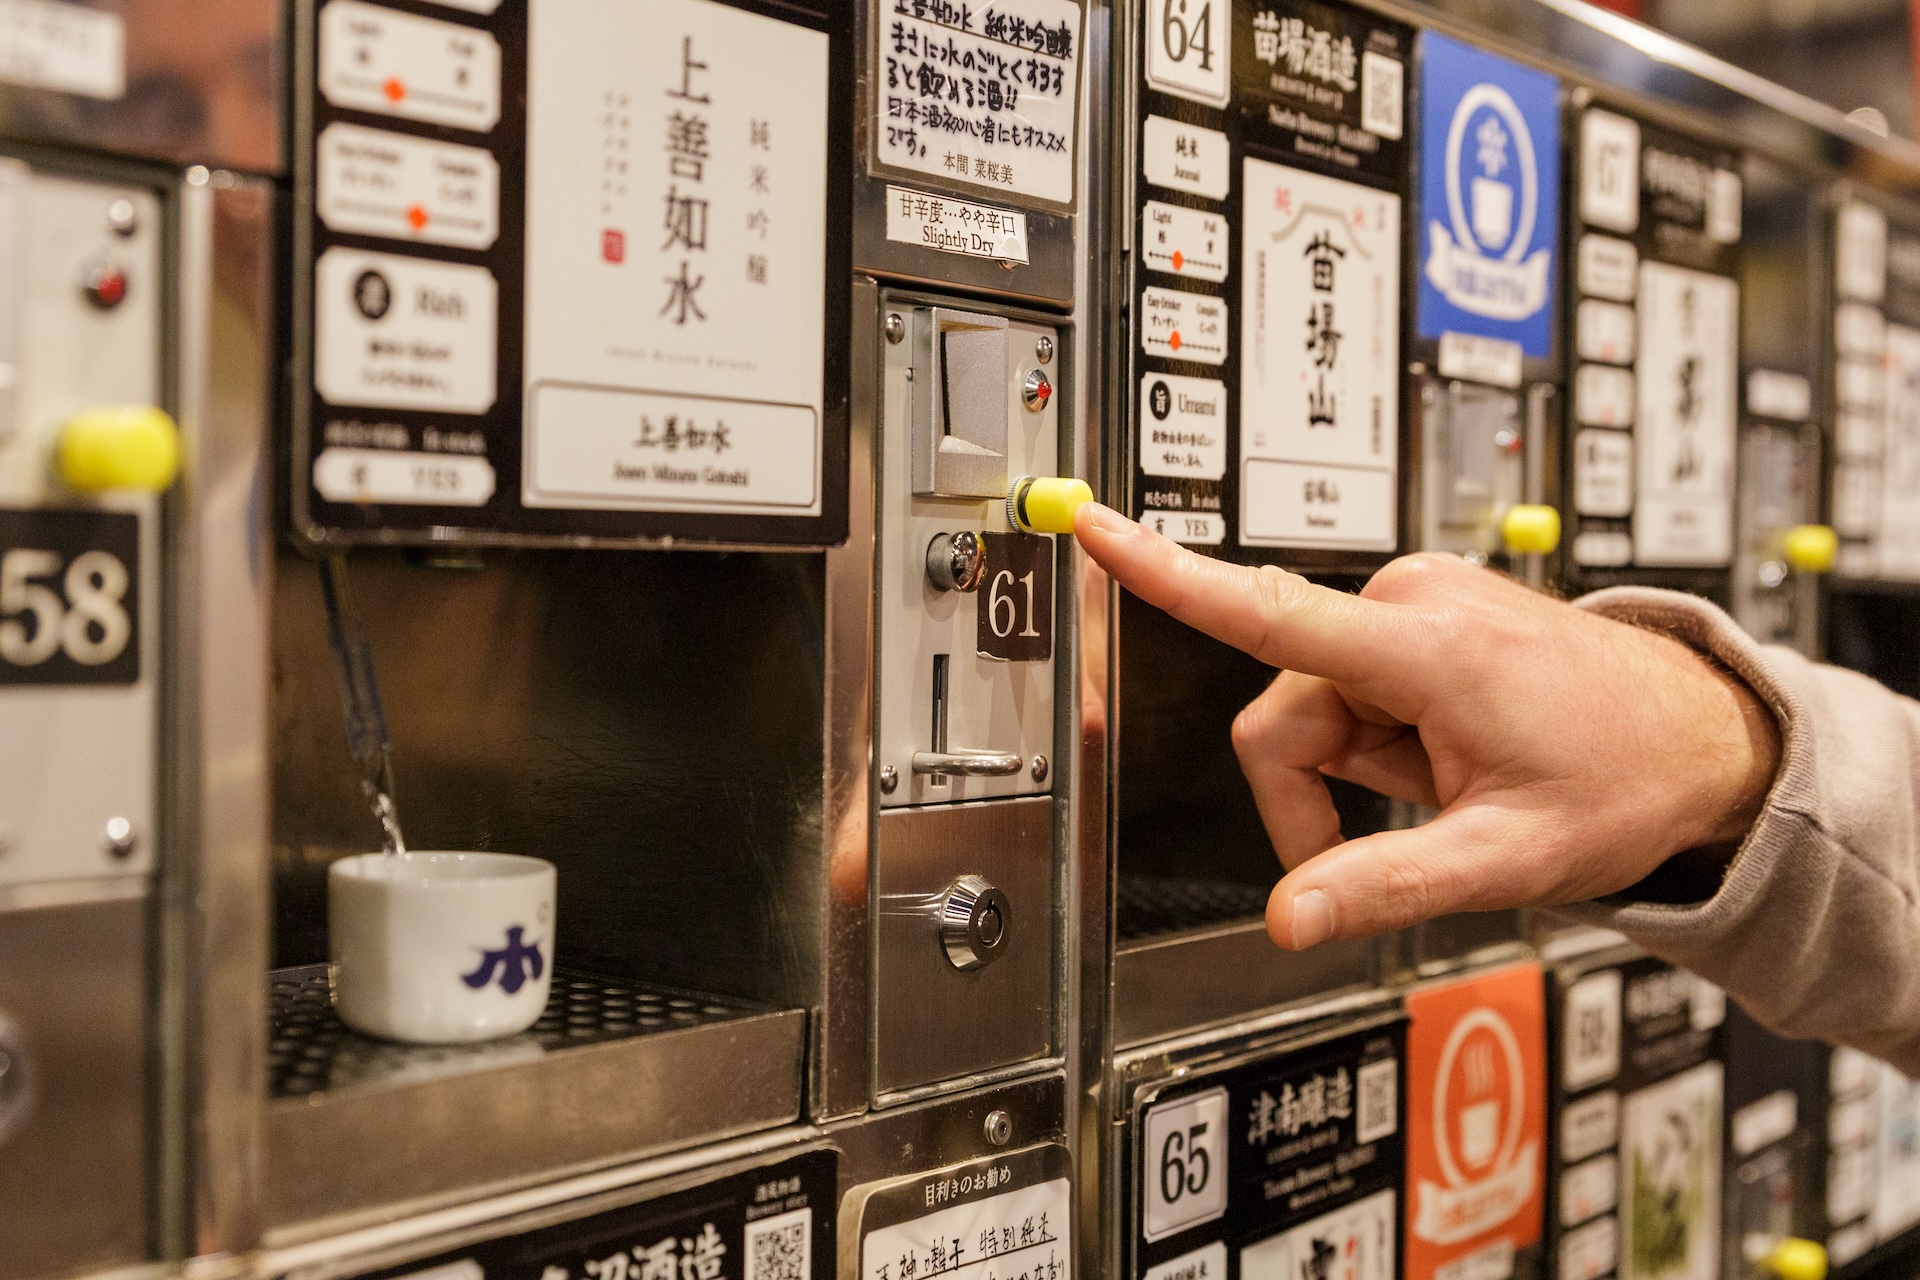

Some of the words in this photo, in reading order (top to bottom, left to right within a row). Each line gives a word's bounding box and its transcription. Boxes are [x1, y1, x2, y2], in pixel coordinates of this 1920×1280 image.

[985, 9, 1073, 60] 純米吟醸
[1163, 0, 1214, 72] 64
[887, 126, 926, 157] です。
[888, 96, 1067, 152] 日本酒初心者にもオススメ
[1175, 134, 1199, 159] 純米
[660, 36, 712, 325] 上善如水
[943, 151, 969, 175] 本間
[974, 158, 1013, 185] 菜桜美
[747, 118, 772, 285] 純米吟醸
[1153, 209, 1171, 225] Light
[923, 226, 968, 252] Slightly
[971, 234, 994, 256] Dry
[1303, 227, 1347, 427] 苗場山
[1178, 393, 1217, 417] Umami
[634, 414, 733, 454] 上善如水
[1185, 519, 1209, 536] YES
[0, 547, 131, 666] 58
[989, 570, 1040, 637] 61
[1161, 1122, 1209, 1204] 65
[925, 1166, 1011, 1207] 目利きのお勧め
[980, 1212, 1054, 1257] 特別純米
